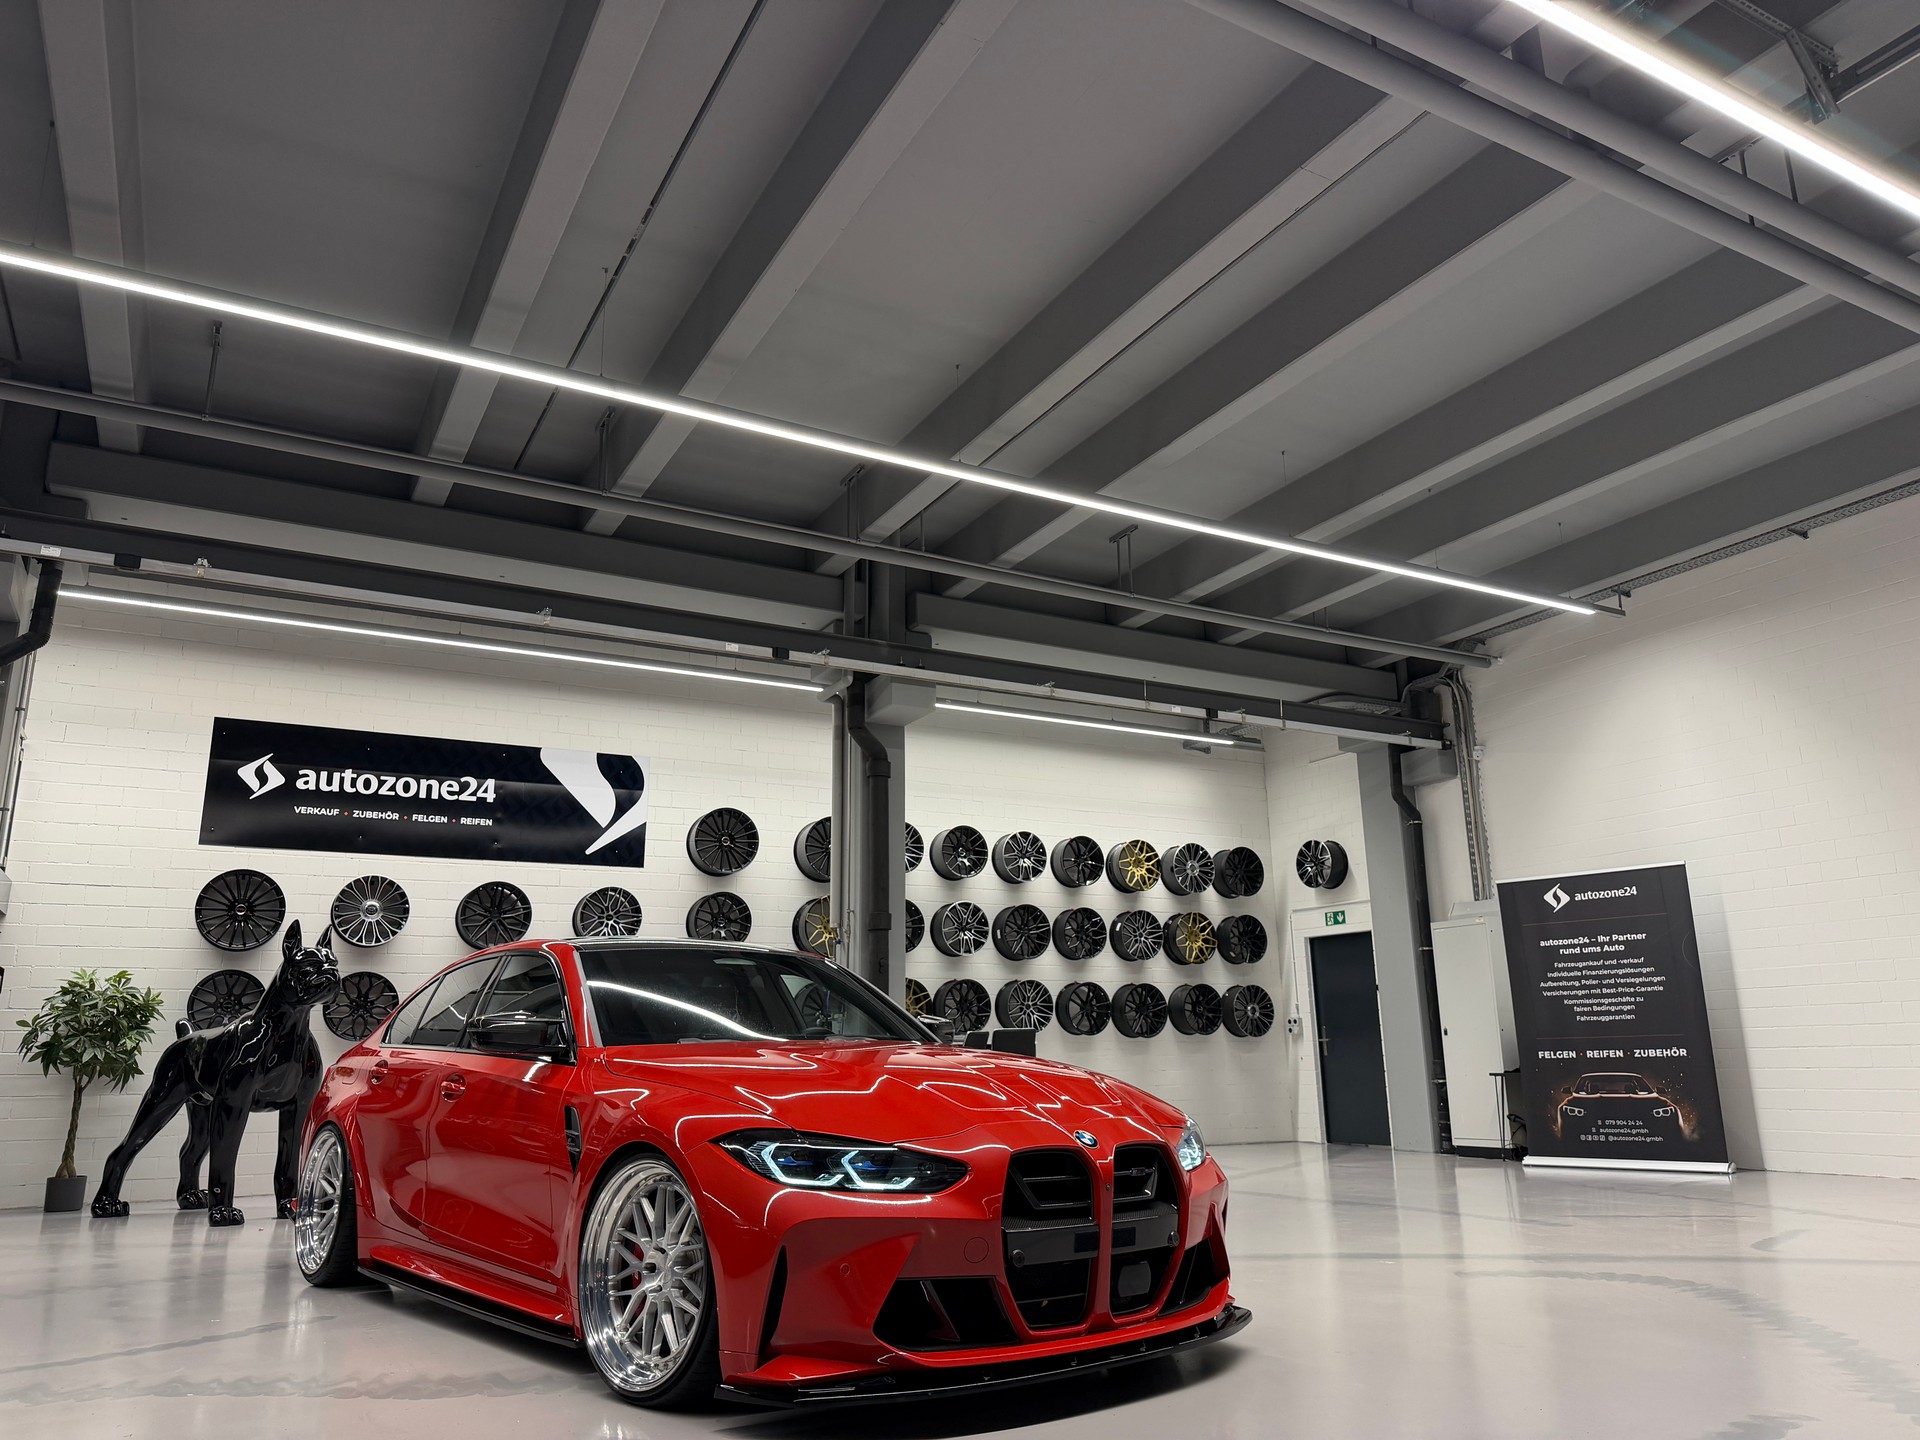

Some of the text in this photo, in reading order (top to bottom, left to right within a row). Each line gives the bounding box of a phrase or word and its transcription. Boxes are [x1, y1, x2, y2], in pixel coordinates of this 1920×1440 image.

[295, 768, 496, 803] autozone24
[294, 806, 493, 827] VERKAUF ZUBEHÖR FELGEN REIFEN
[1574, 886, 1637, 901] autozone24
[1540, 936, 1589, 947] autozone24
[1598, 935, 1610, 943] Ihr
[1612, 933, 1647, 941] Partner
[1560, 947, 1580, 955] rund
[1603, 944, 1625, 952] Auto
[1554, 960, 1604, 968] Fahrzeugankauf
[1548, 967, 1655, 978] Individuelle Finanzierungslösungen
[1616, 975, 1666, 984] Versiegelungen
[1593, 1004, 1635, 1012] Bedingungen
[1538, 1047, 1687, 1059] FELGEN REIFEN ZUBEHÖR
